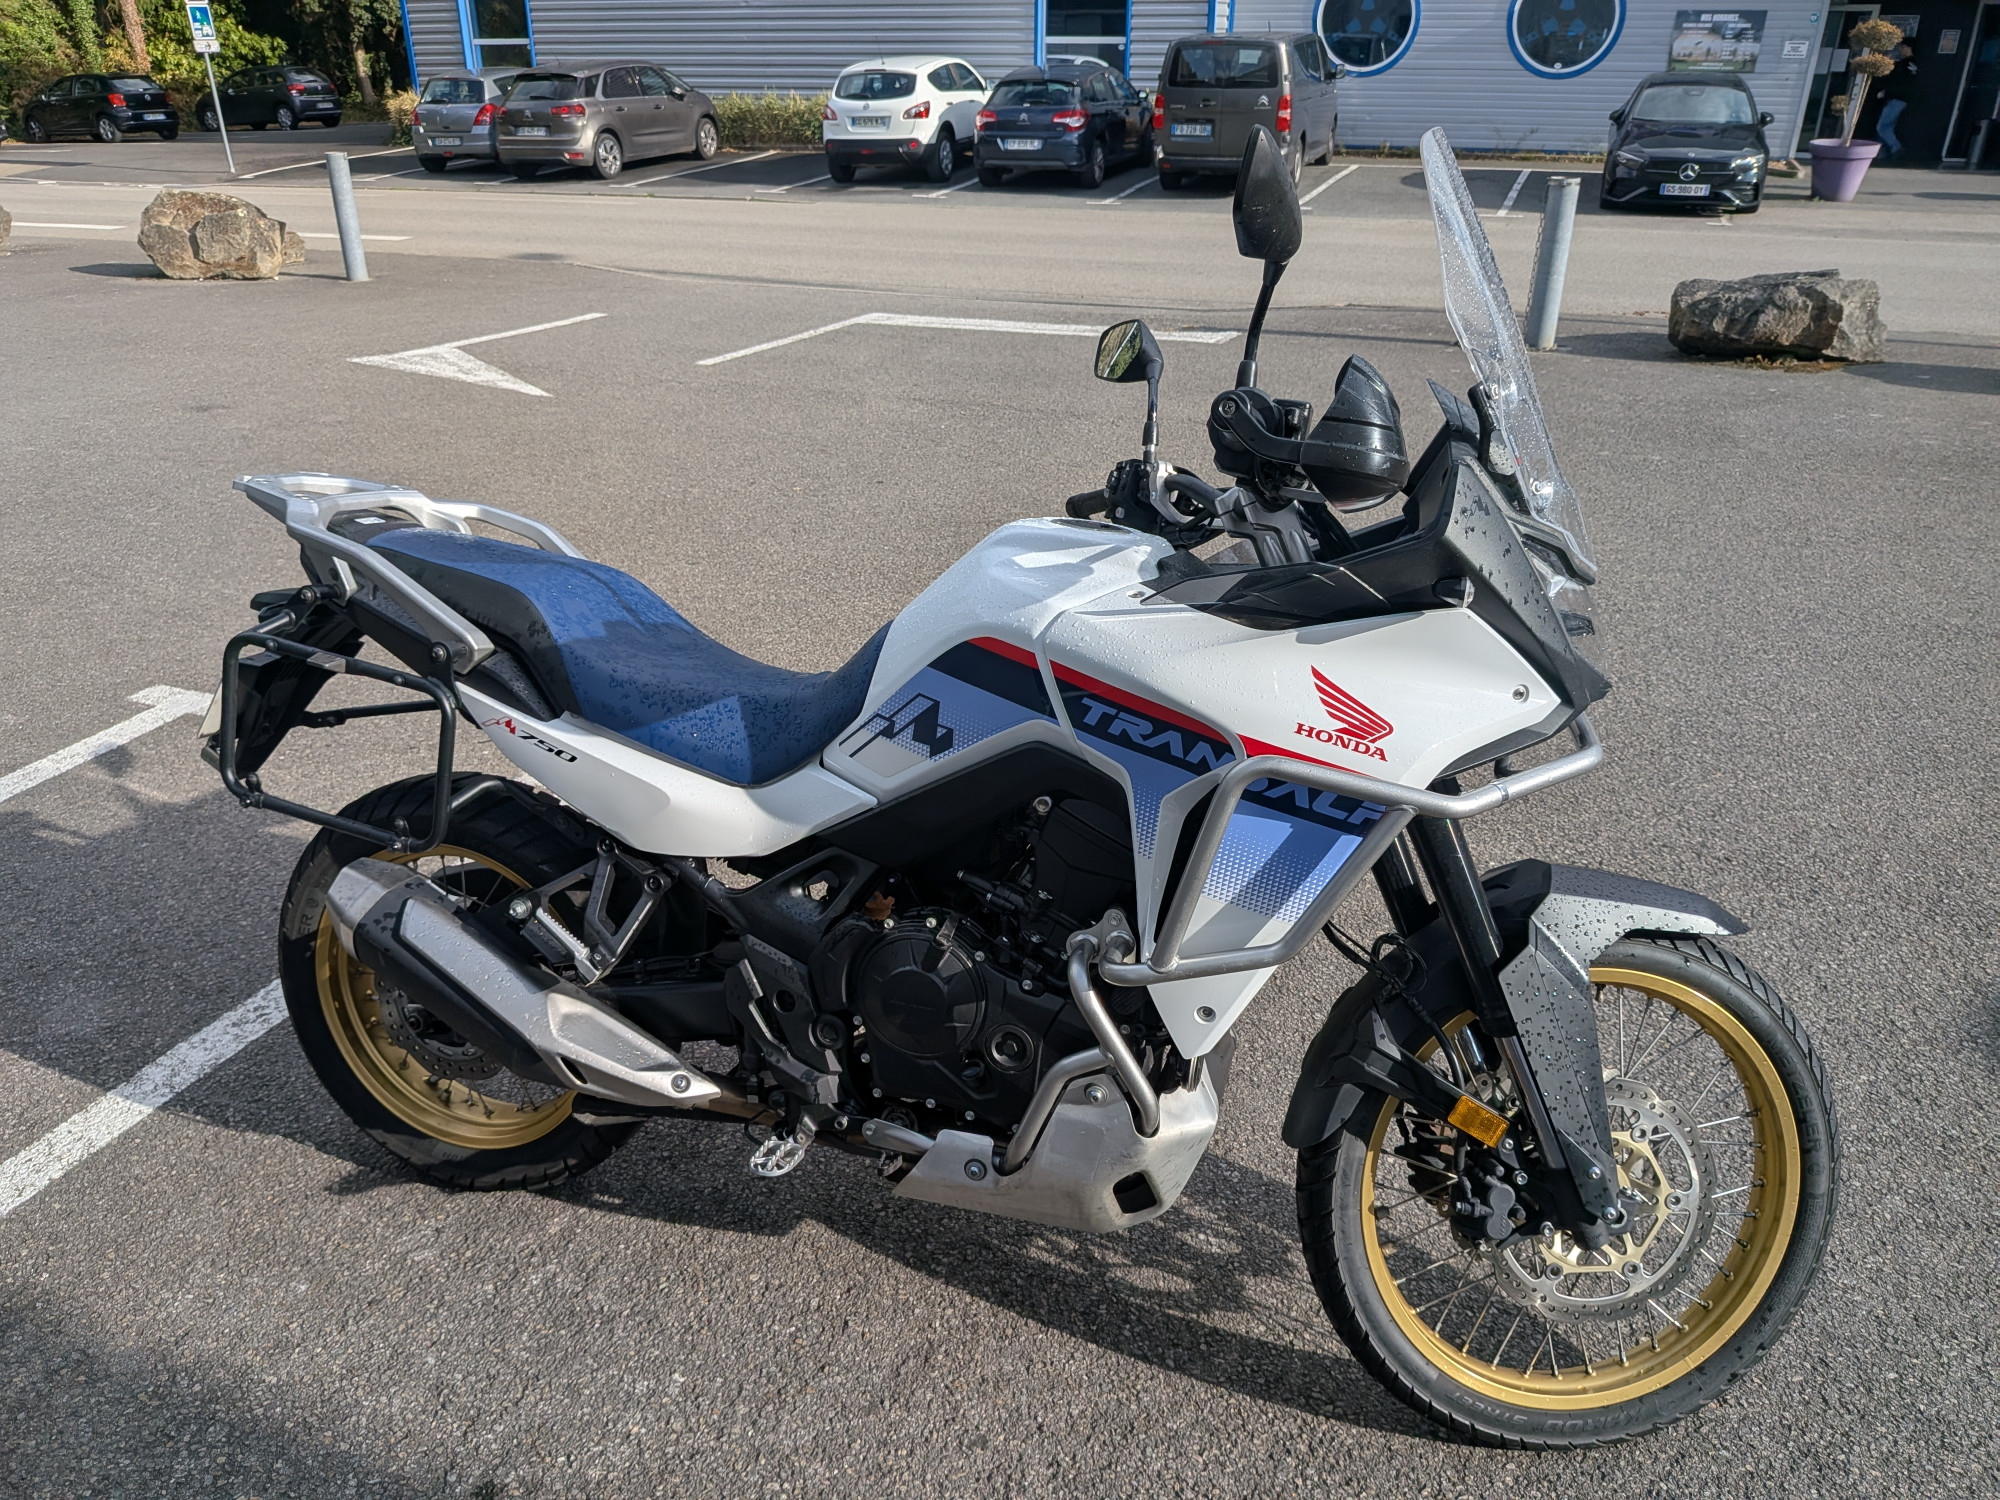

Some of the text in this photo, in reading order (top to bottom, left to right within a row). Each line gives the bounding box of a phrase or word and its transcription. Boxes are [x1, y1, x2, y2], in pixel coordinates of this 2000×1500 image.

[518, 730, 578, 763] 750
[1294, 722, 1389, 762] HONDA
[1081, 697, 1387, 825] TRANALP
[1444, 1391, 1528, 1425] STREET
